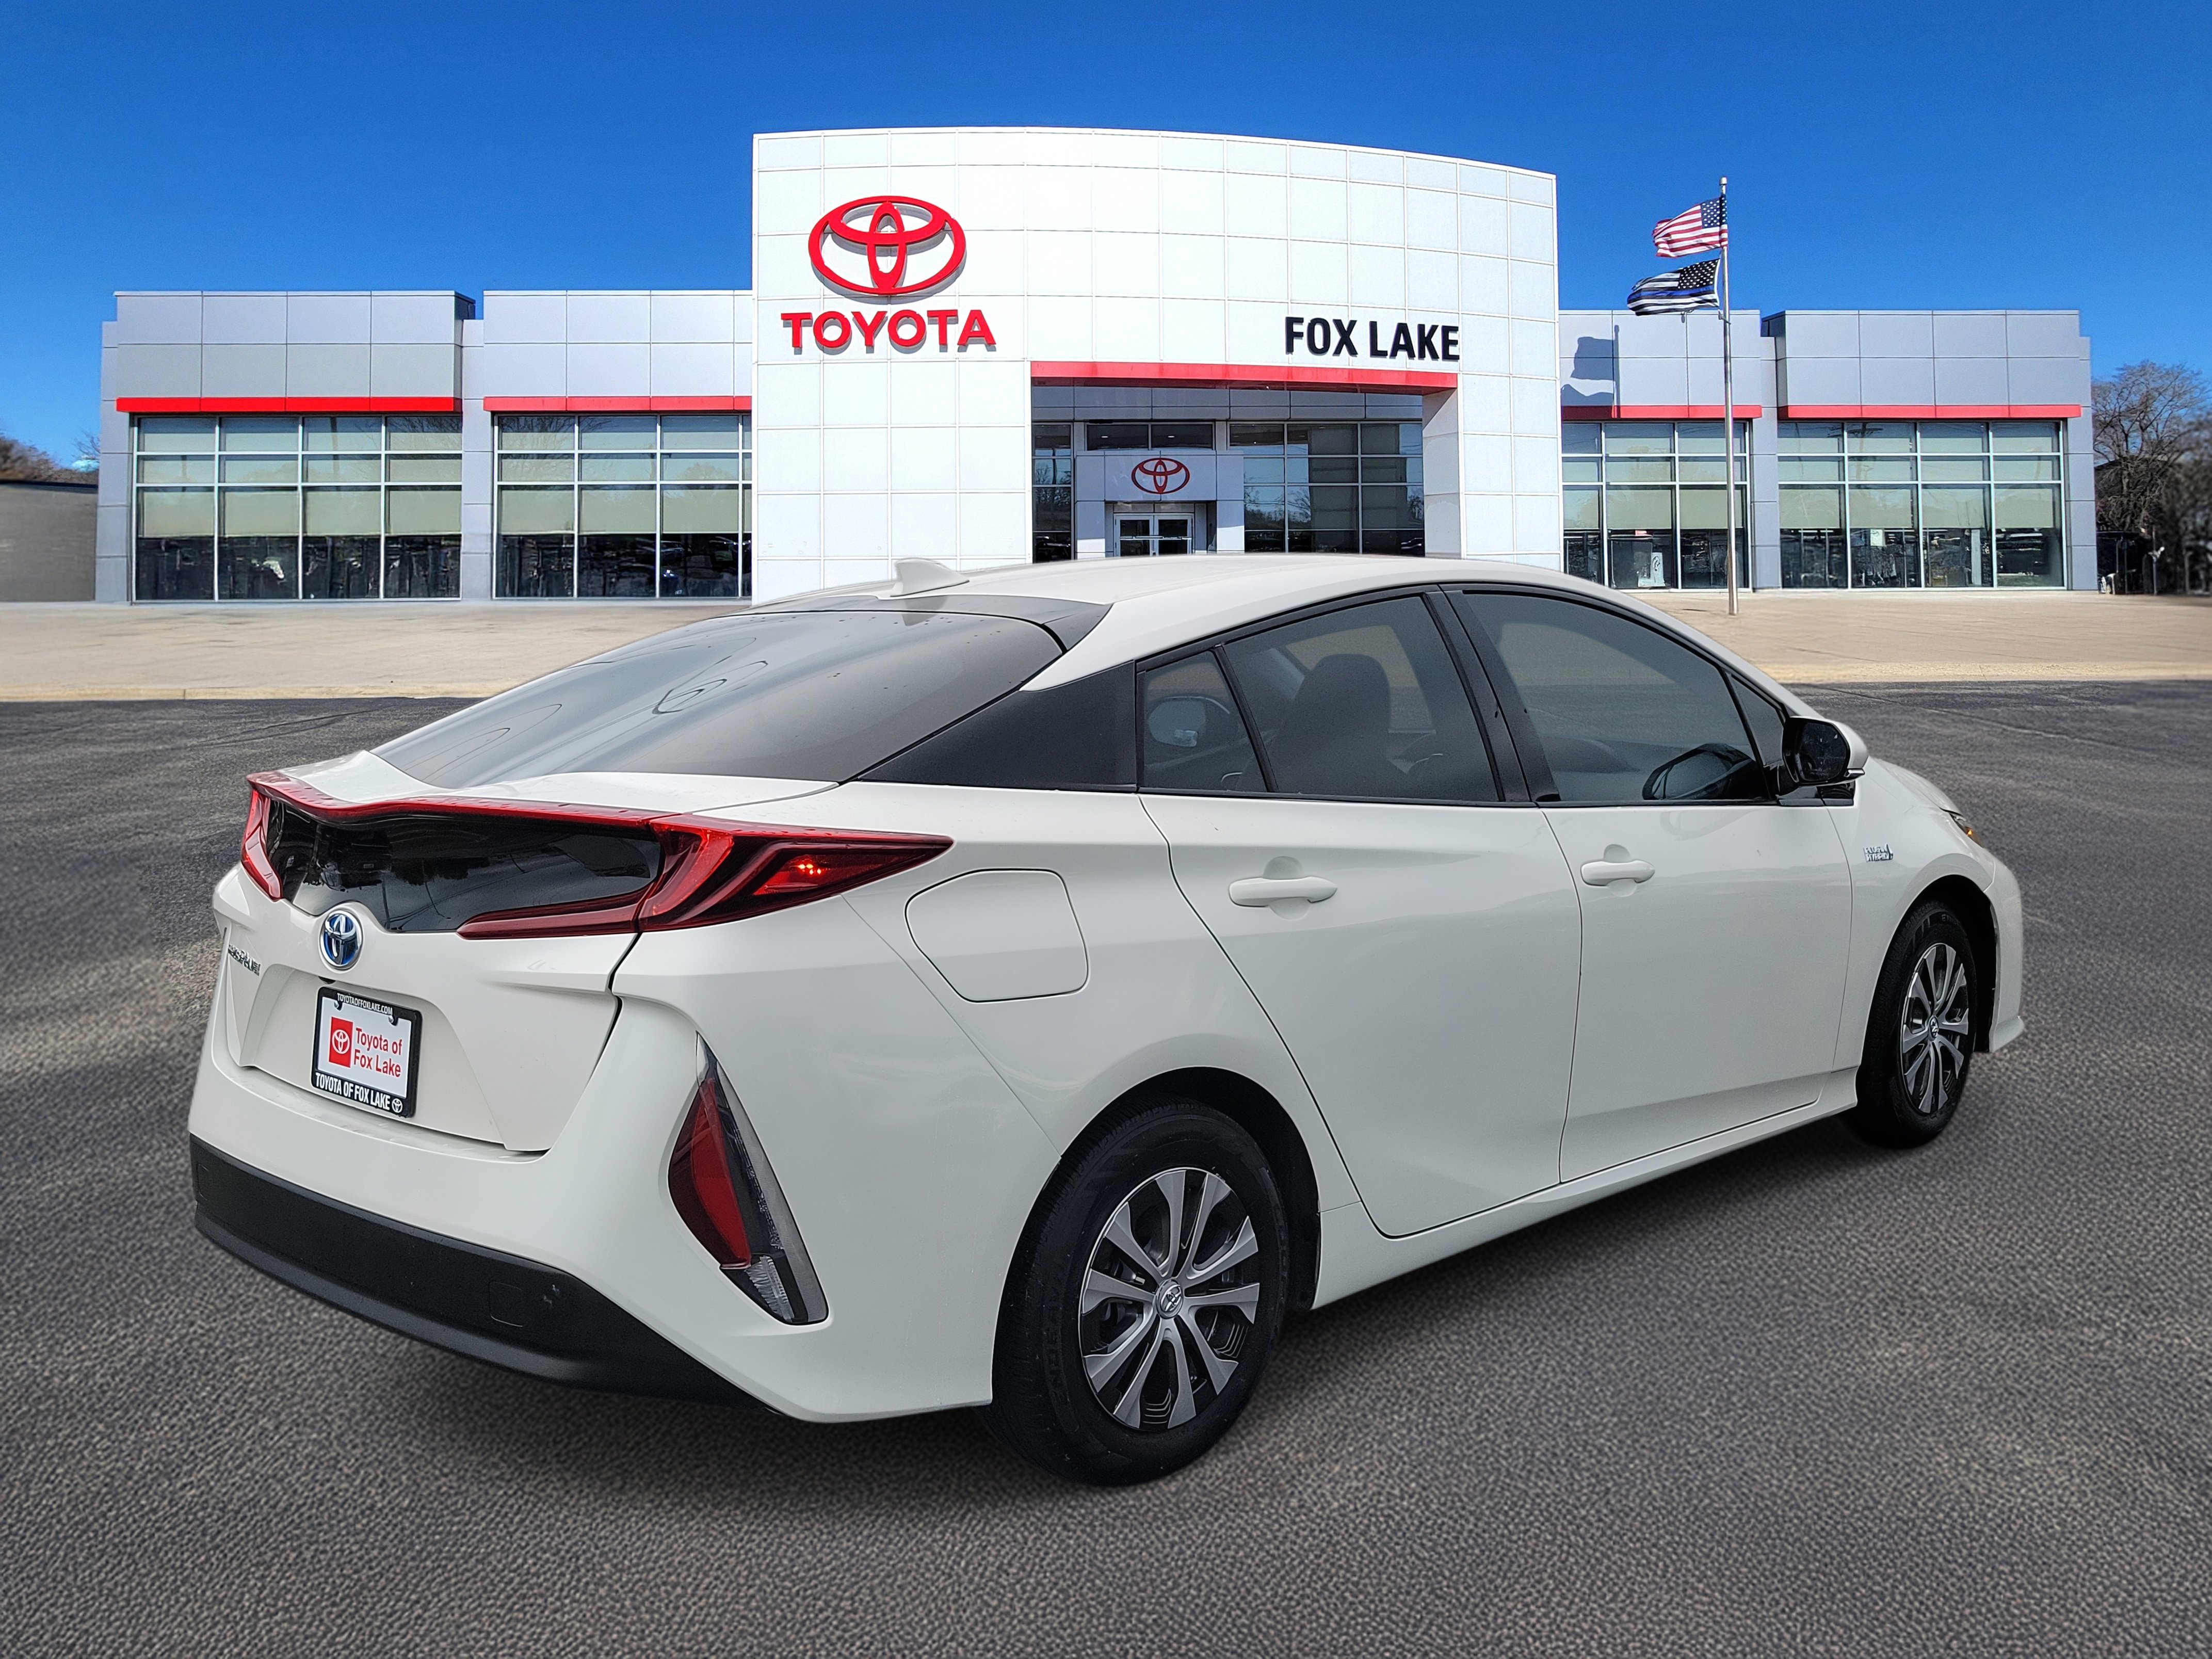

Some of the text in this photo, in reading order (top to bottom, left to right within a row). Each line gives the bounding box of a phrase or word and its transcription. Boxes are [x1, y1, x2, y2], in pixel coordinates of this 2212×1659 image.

[781, 309, 996, 349] TOYOTA
[1286, 316, 1460, 361] FOX LAKE
[337, 993, 393, 1016] TOYOTAOFFOXLAKE.COM
[356, 1027, 402, 1056] Toyota of
[353, 1049, 401, 1077] Fox Lake
[315, 1072, 391, 1110] TOYOTA OF FOX LAKE
